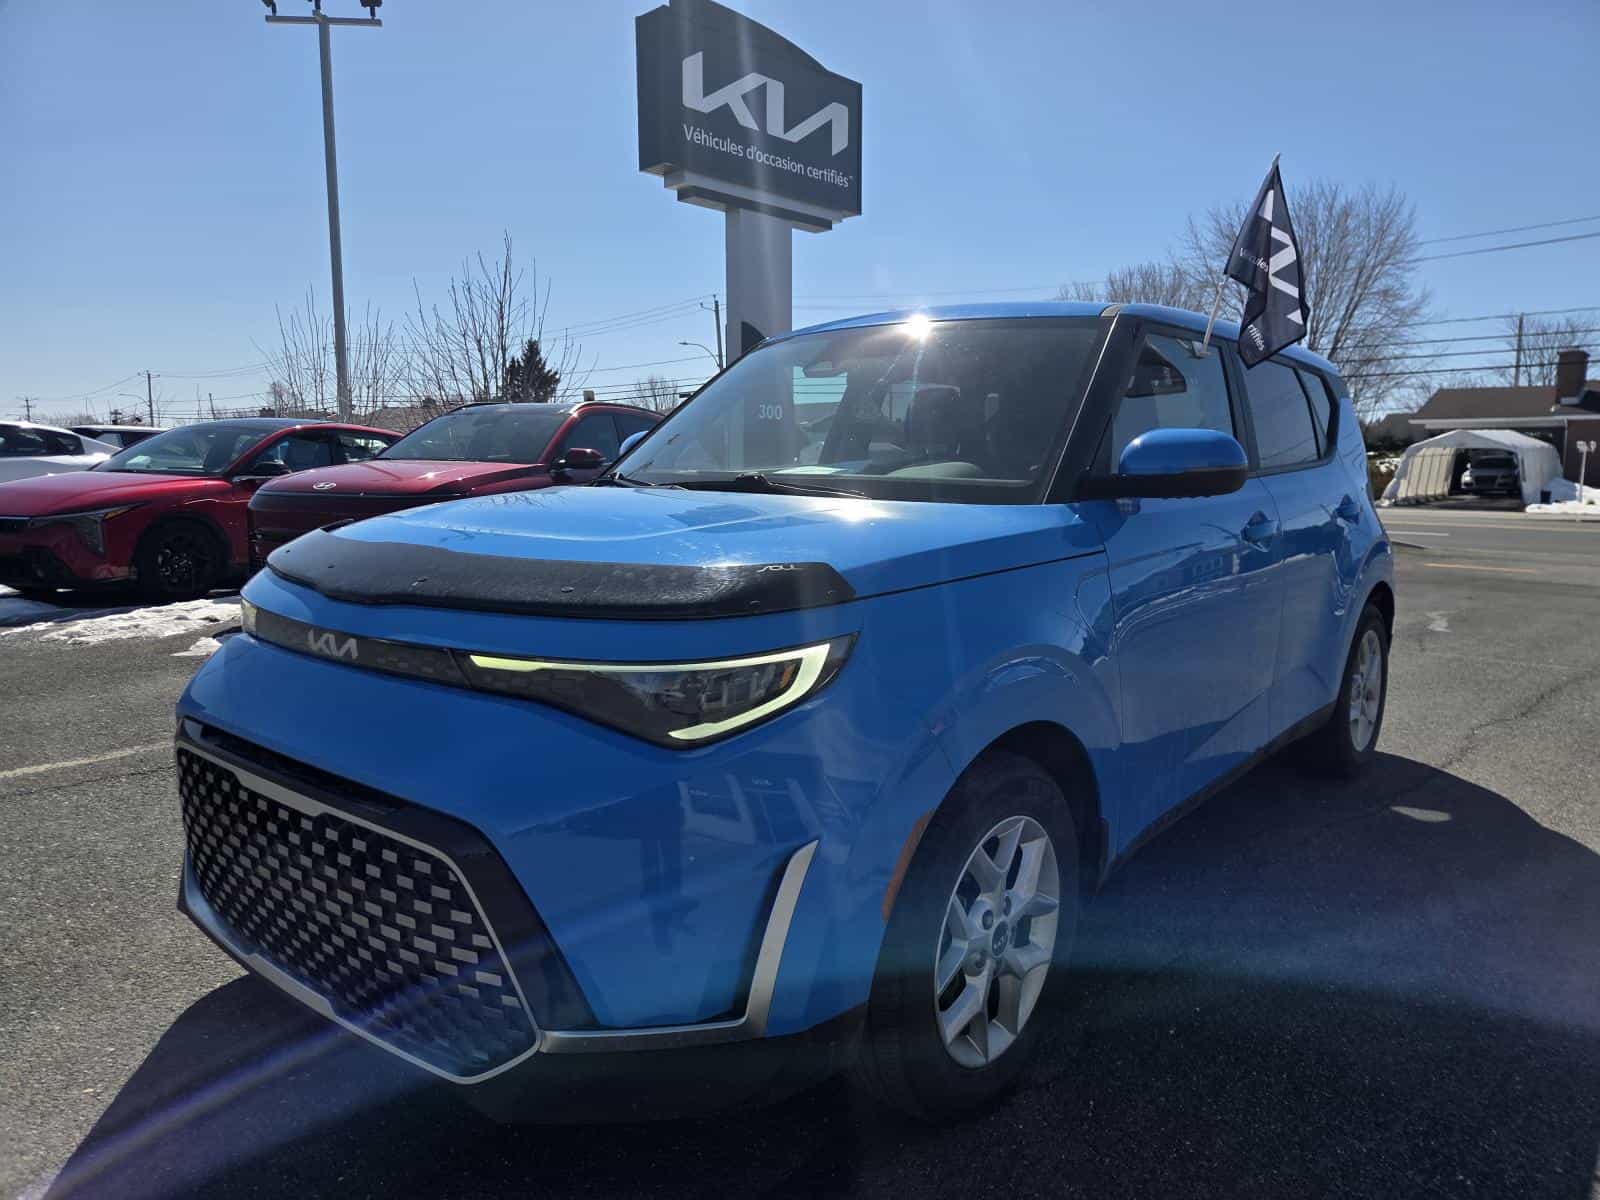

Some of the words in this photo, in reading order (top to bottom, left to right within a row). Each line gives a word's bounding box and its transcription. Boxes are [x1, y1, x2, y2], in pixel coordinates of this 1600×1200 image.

[682, 51, 848, 156] KIA
[683, 124, 744, 157] Véhicules
[746, 146, 805, 175] d'occasion
[807, 166, 849, 187] certifiés
[1247, 324, 1265, 351] rtifiés
[759, 403, 783, 420] 300
[308, 628, 359, 659] KIA
